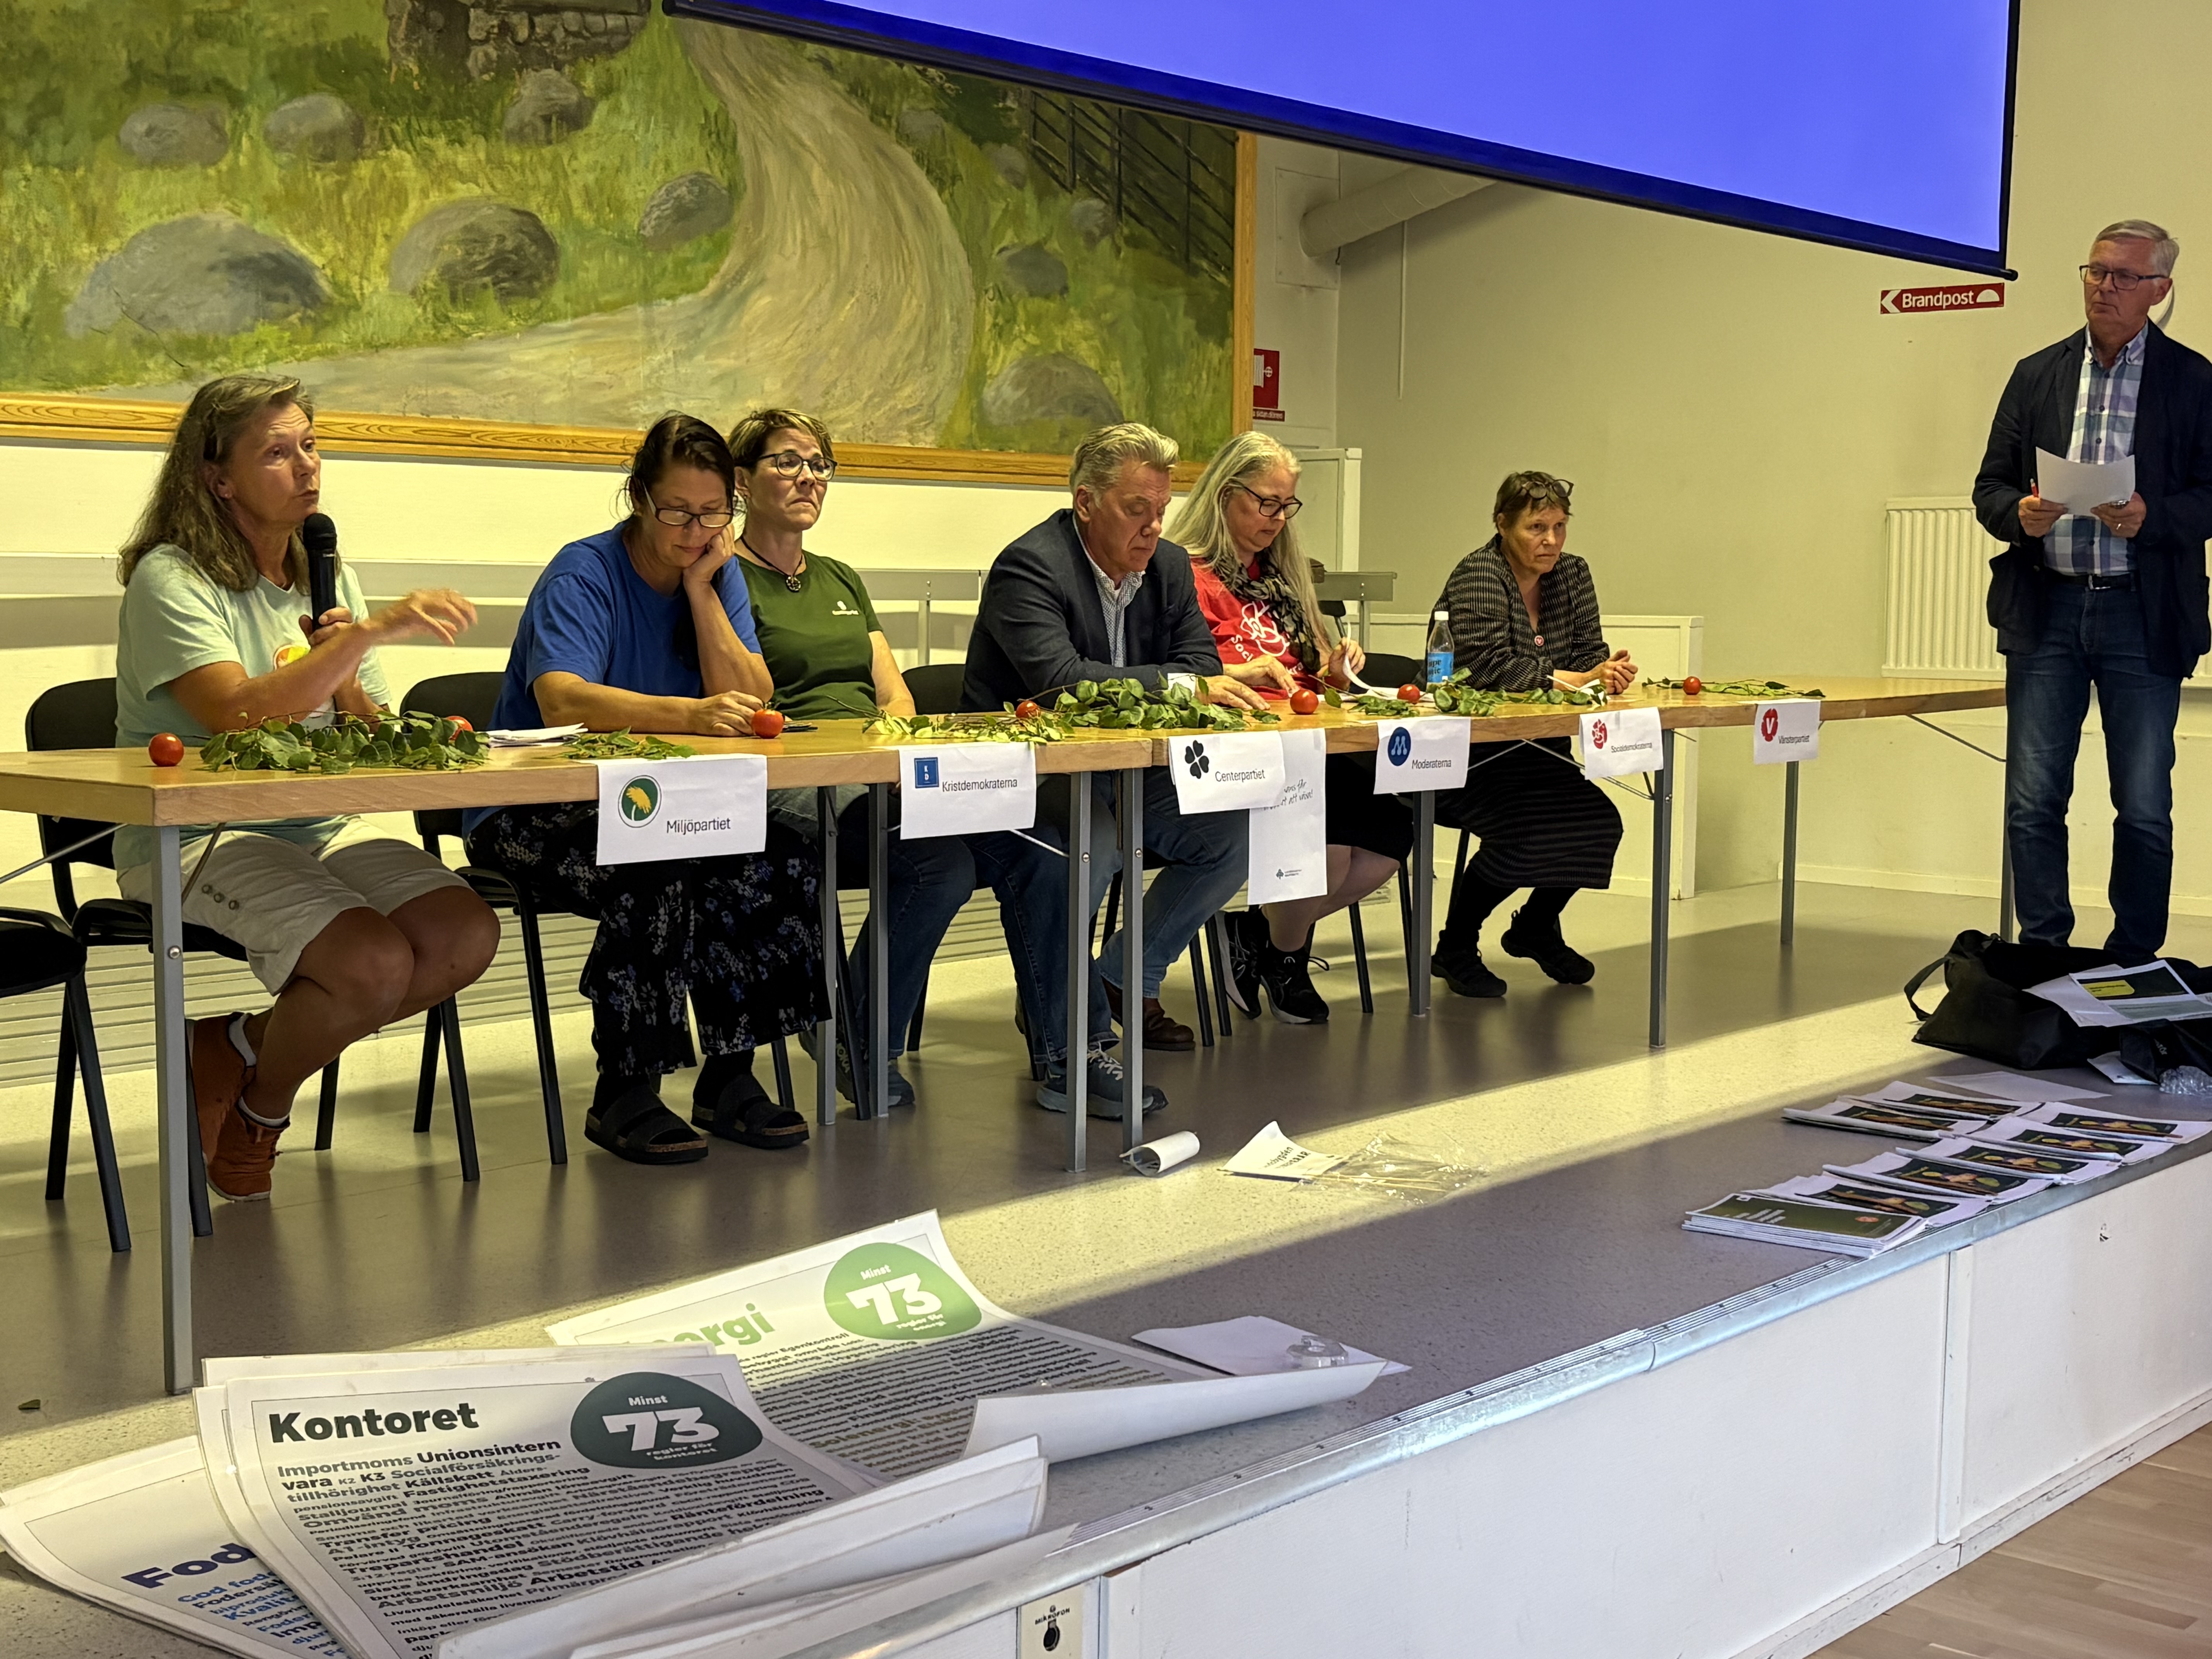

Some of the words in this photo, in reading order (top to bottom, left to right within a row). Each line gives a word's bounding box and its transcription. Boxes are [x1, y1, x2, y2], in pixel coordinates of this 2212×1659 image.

[1902, 291, 1974, 309] Brandpost
[1215, 768, 1266, 783] Centerpartiet
[1412, 759, 1451, 769] Moderaterna
[942, 778, 1018, 792] Kristdemokraterna
[666, 817, 731, 835] Miljöpartiet
[860, 1264, 891, 1280] Minst
[845, 1273, 942, 1325] 73
[779, 1333, 849, 1352] Egenkontroll
[628, 1395, 668, 1406] Minst
[269, 1403, 479, 1443] Kontoret
[602, 1407, 719, 1451] 73
[278, 1455, 413, 1477] Importmoms
[417, 1441, 562, 1463] Unionsintern
[647, 1445, 688, 1456] regler
[692, 1442, 713, 1450] för
[653, 1448, 719, 1461] kontoret
[282, 1478, 333, 1491] vara
[360, 1472, 386, 1482] K3
[391, 1454, 560, 1479] Socialförsäkrings-
[287, 1483, 401, 1502] tillhörighet
[405, 1472, 495, 1488] Källskatt
[294, 1495, 398, 1514] pensionsavgift
[403, 1468, 590, 1498] Fastighetstaxering
[298, 1501, 407, 1521] Stalljournal
[303, 1508, 407, 1528] Omvänd
[413, 1497, 488, 1512] moms
[495, 1488, 552, 1500] Allmän
[319, 1530, 410, 1548] Transfer
[417, 1517, 492, 1534] pricing
[343, 1540, 524, 1574] Trepartshandel
[670, 1490, 824, 1520] Räntefördelning
[402, 1523, 546, 1550] Tonnageskatt
[551, 1502, 666, 1525] Carry-forward
[469, 1514, 649, 1546] Utomståenderegeln
[328, 1536, 421, 1555] A1-intyg
[443, 1542, 574, 1567] SAM-ansökan
[369, 1573, 527, 1601] bruksverksamhet
[378, 1580, 522, 1609] Arbetsmiljö
[531, 1560, 645, 1585] Arbetstid
[416, 1565, 534, 1587] ändringsdag
[1035, 1607, 1070, 1625] MIKROFON
